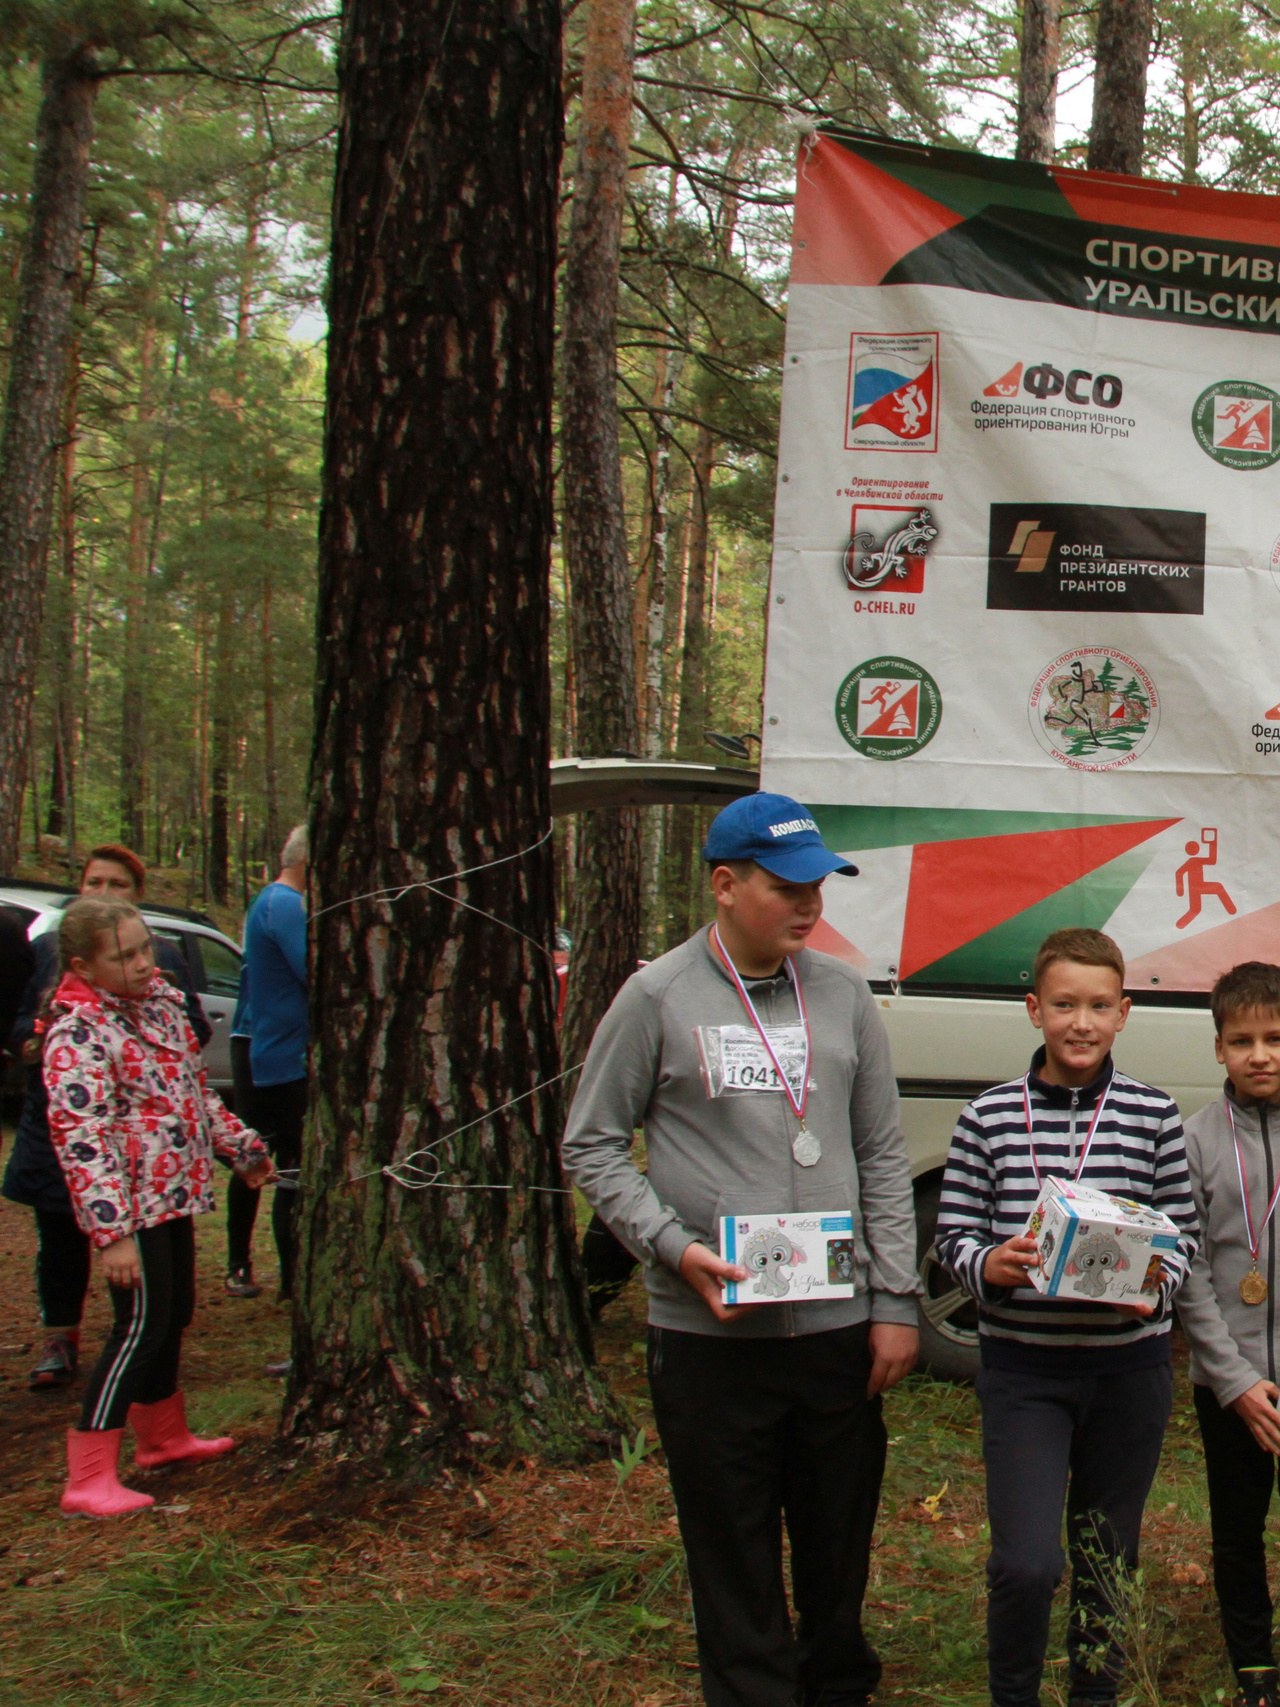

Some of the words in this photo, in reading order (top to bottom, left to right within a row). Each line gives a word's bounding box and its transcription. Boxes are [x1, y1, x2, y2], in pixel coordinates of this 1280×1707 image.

[1023, 362, 1123, 409] ФСО
[970, 400, 1047, 417] Федерация
[1051, 407, 1136, 427] спортивного
[974, 417, 1087, 433] ориентирования
[1090, 422, 1130, 439] Югры
[852, 476, 930, 490] Ориентирование
[836, 489, 842, 497] в
[844, 487, 902, 500] Челябинской
[905, 492, 944, 501] области
[1059, 544, 1104, 558] ФОНД
[1059, 562, 1190, 578] ПРЕЗИДЕНТСКИХ
[1059, 580, 1127, 593] ГРАНТОВ
[853, 600, 916, 615] O-CHEL.RU
[1055, 648, 1110, 666] СПОРТИВНОГО
[1110, 648, 1158, 708] ОРИЕНТИРОВАНИЯ
[1050, 748, 1099, 772] КУРГАНСКОЙ
[1101, 752, 1138, 772] ОБЛАСТИ
[727, 1066, 781, 1087] 1041
